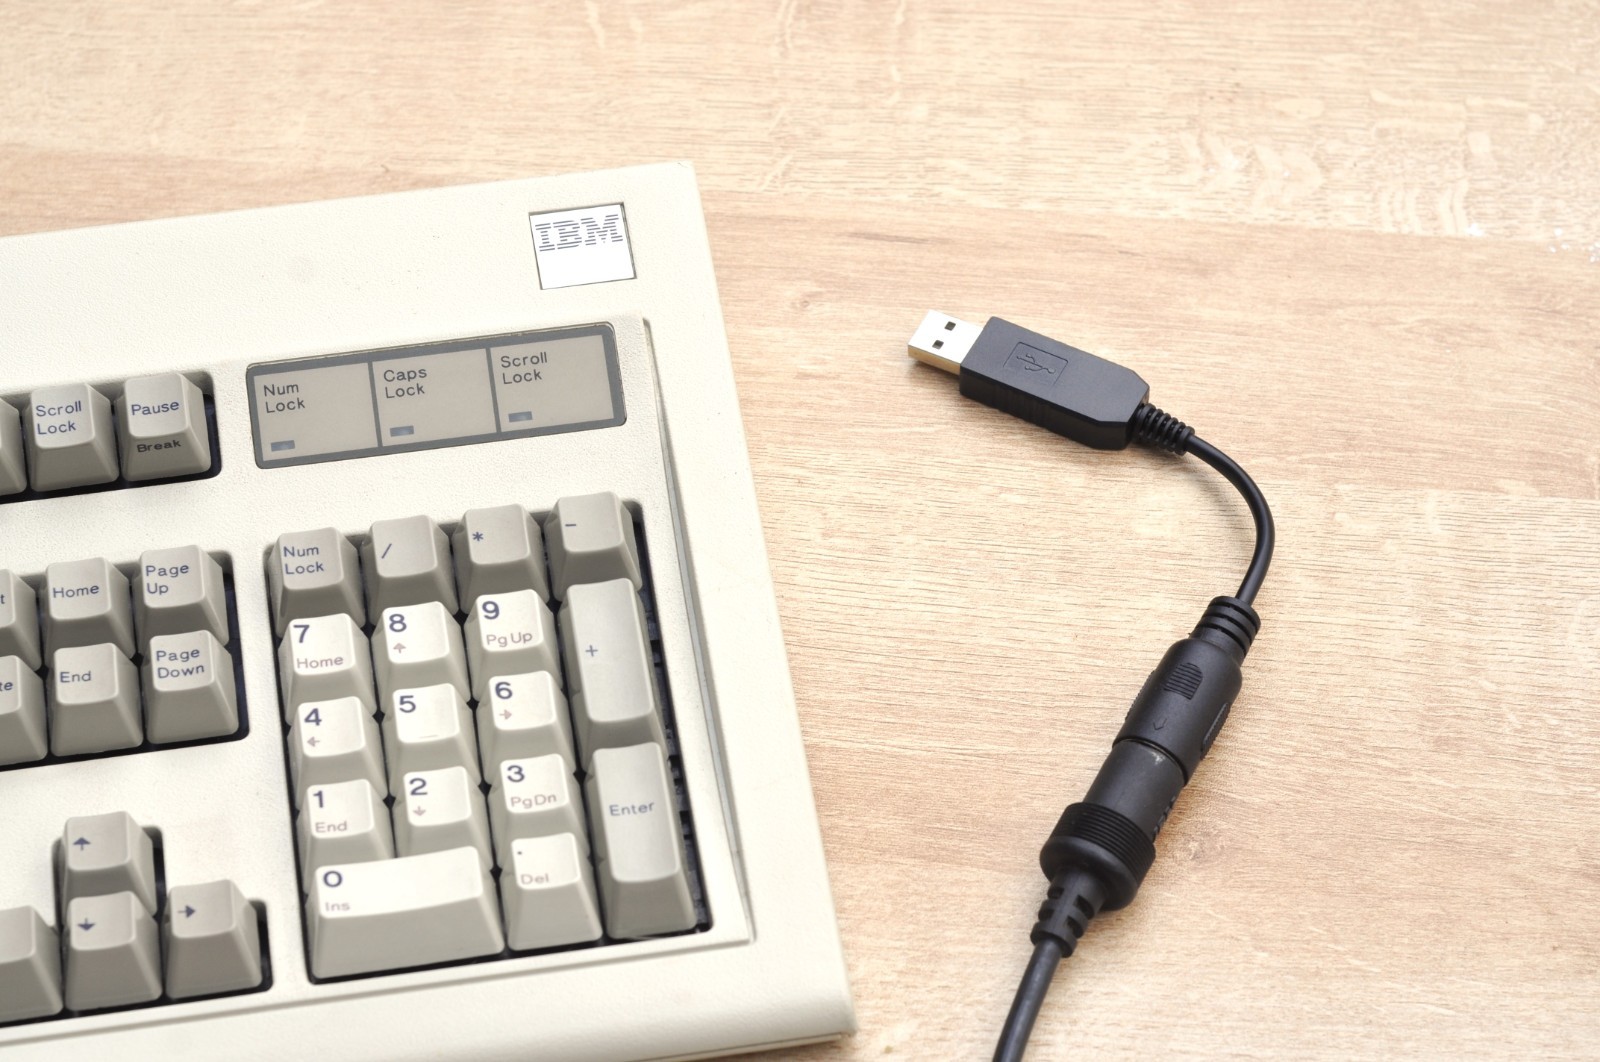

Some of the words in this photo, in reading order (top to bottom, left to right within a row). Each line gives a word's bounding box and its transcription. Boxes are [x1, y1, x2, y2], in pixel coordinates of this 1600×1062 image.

[535, 214, 623, 252] IBM
[501, 352, 548, 369] Scroll
[383, 367, 427, 383] Caps
[503, 368, 543, 385] Lock
[264, 383, 299, 397] Num
[385, 383, 425, 399] Lock
[35, 400, 82, 417] Scroll
[130, 401, 180, 416] Pause
[265, 397, 306, 414] Lock
[36, 420, 77, 435] Lock
[137, 439, 182, 453] Break
[283, 545, 320, 558] Num
[145, 564, 190, 578] Page
[285, 561, 325, 576] Lock
[52, 585, 100, 599] Home
[146, 583, 169, 595] Up
[482, 600, 500, 620] 9
[388, 613, 407, 633] 8
[293, 623, 310, 644] 7
[156, 649, 201, 663] Page
[296, 654, 344, 670] Home
[59, 670, 92, 683] End
[157, 664, 205, 679] Down
[494, 681, 513, 700] 6
[398, 695, 417, 713] 5
[304, 708, 323, 726] 4
[506, 764, 525, 783] 3
[409, 778, 428, 796] 2
[313, 790, 325, 808] 1
[609, 801, 655, 817] Enter
[315, 820, 348, 834] End
[520, 872, 550, 885] Del
[324, 900, 351, 913] Ins
